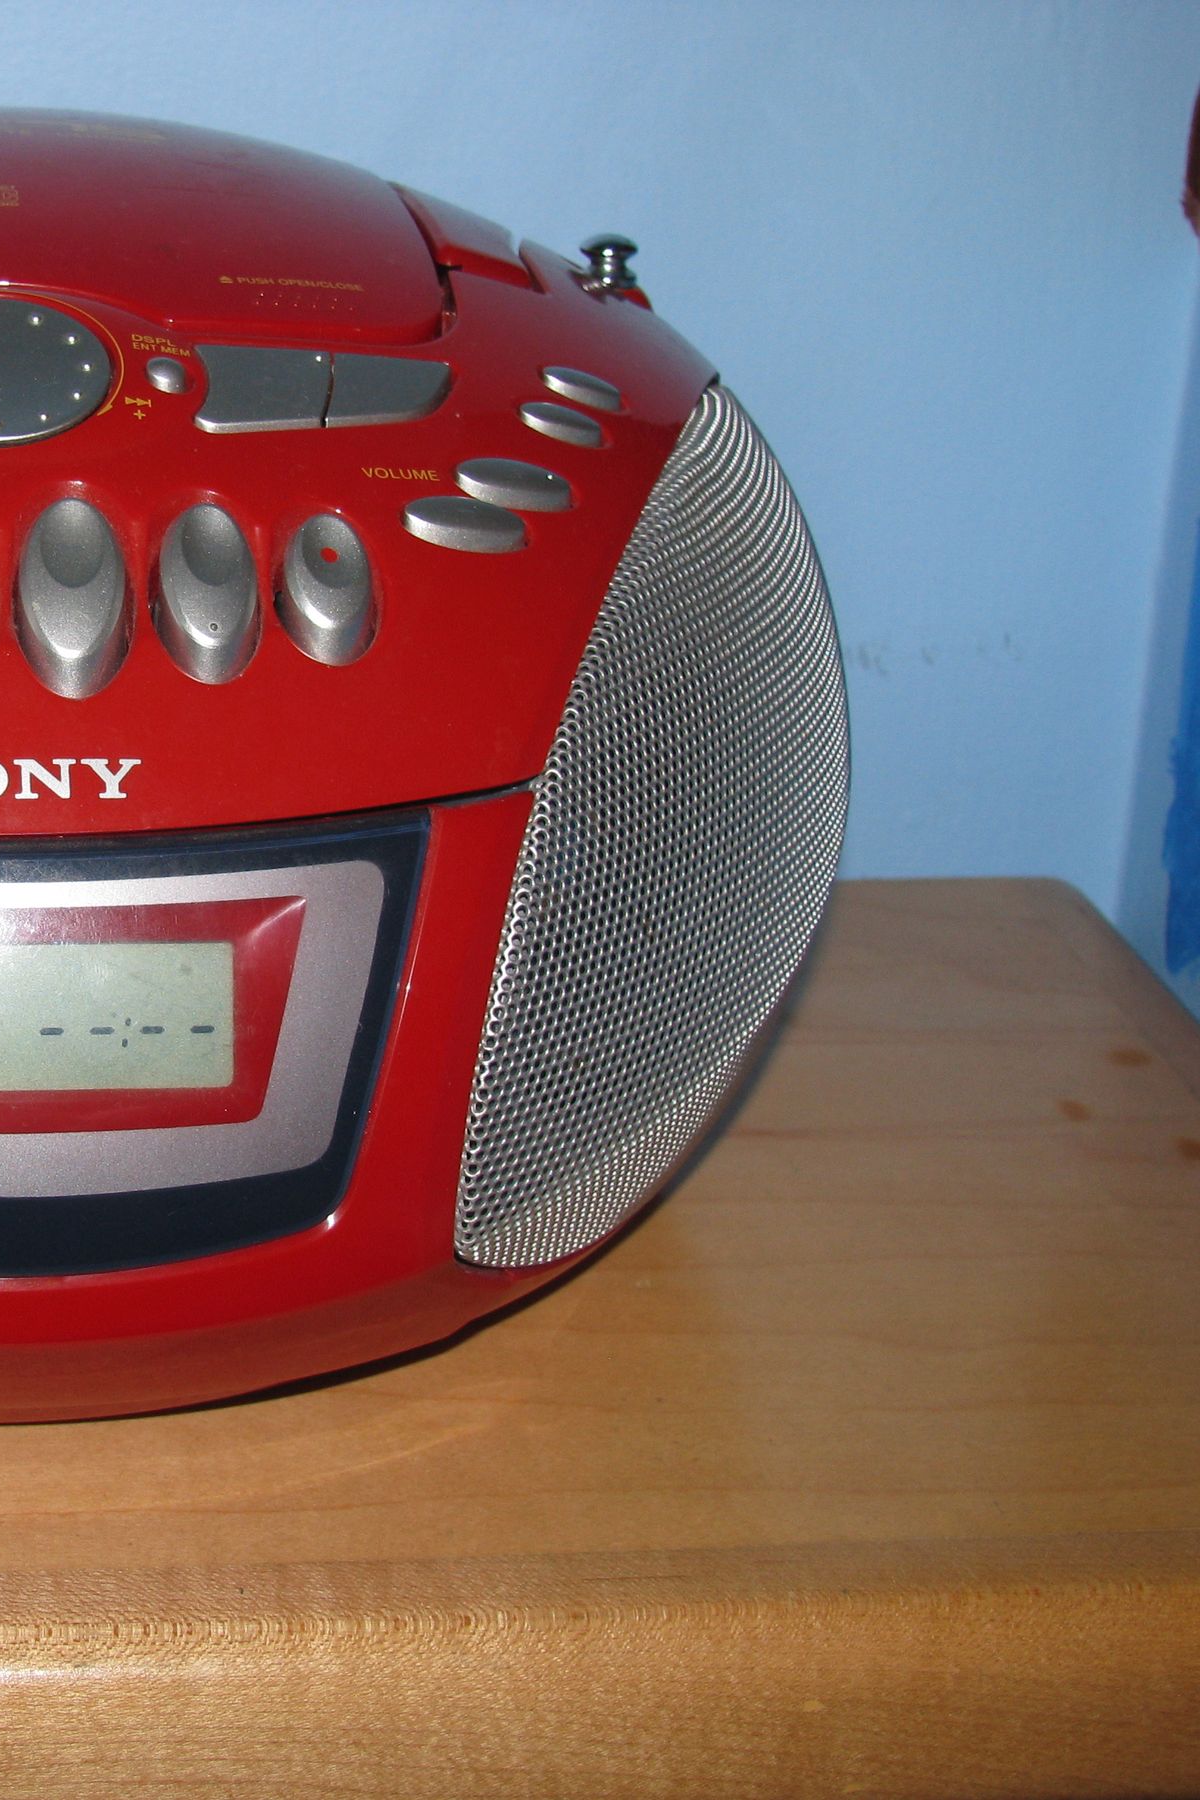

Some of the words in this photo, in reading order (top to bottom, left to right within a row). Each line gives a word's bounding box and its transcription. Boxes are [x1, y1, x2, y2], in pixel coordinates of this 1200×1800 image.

[236, 276, 275, 285] PUSH
[131, 334, 176, 347] DSPL
[132, 342, 156, 351] ENT
[160, 346, 191, 357] MEM
[361, 466, 441, 483] VOLUME
